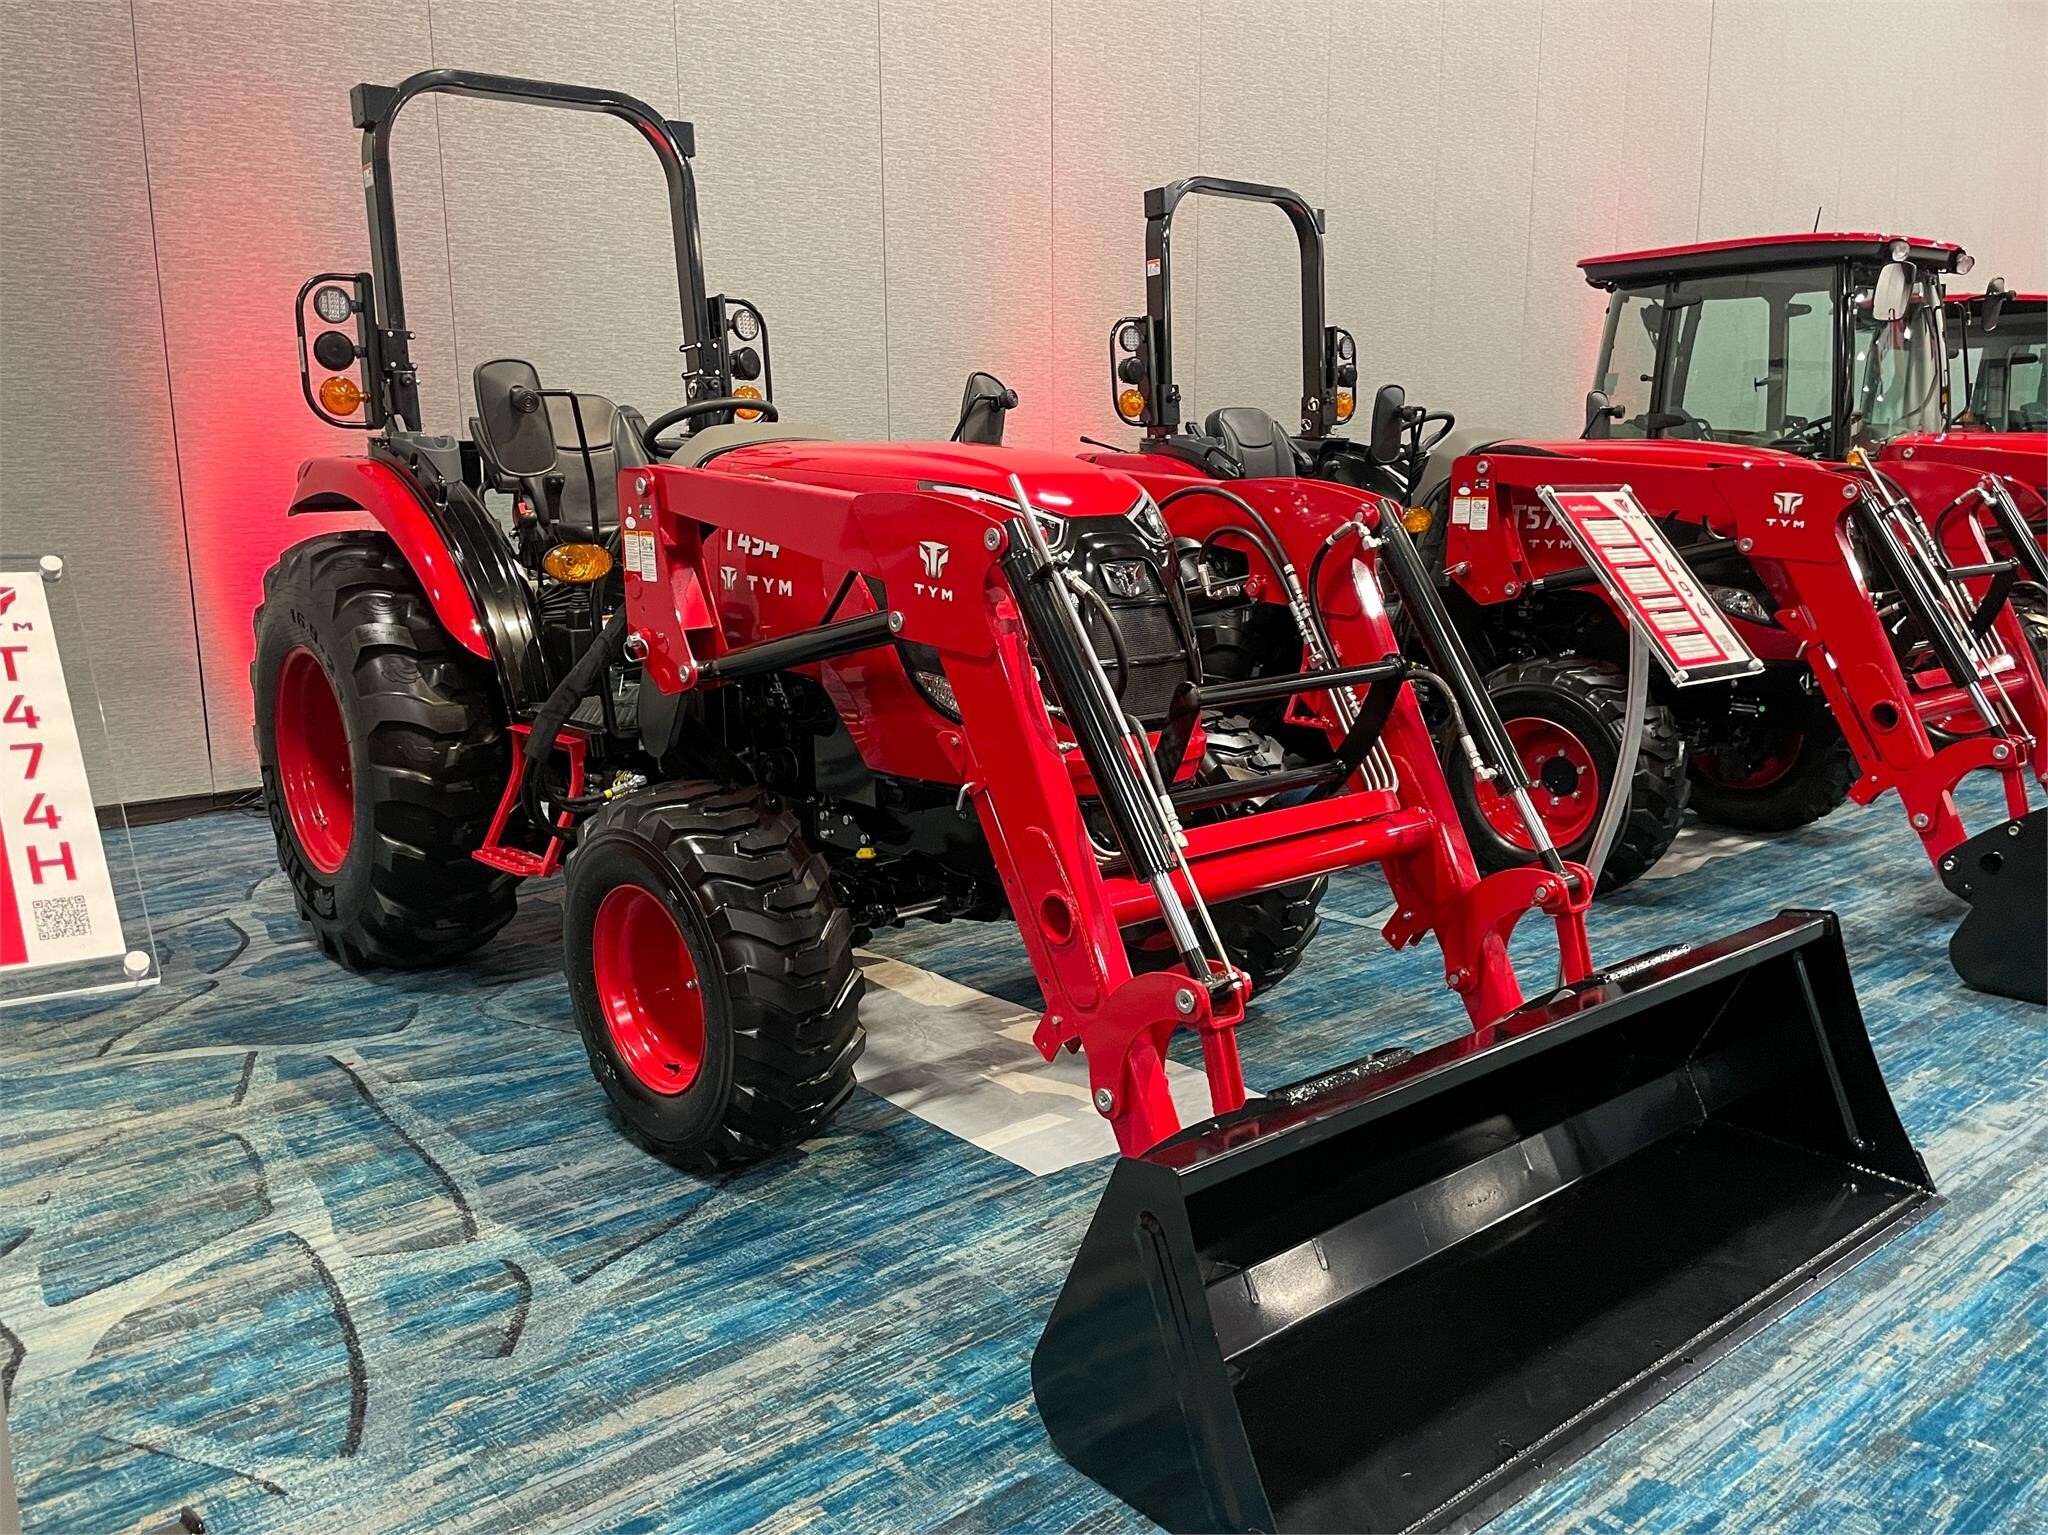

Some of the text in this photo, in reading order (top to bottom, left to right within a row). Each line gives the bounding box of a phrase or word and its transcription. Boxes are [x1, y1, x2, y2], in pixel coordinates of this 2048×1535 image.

[1512, 505, 1561, 529] T57
[1766, 518, 1805, 529] TYM
[1529, 539, 1572, 549] TYM
[746, 574, 793, 597] TYM
[914, 582, 953, 602] TYM
[0, 645, 78, 885] T474H
